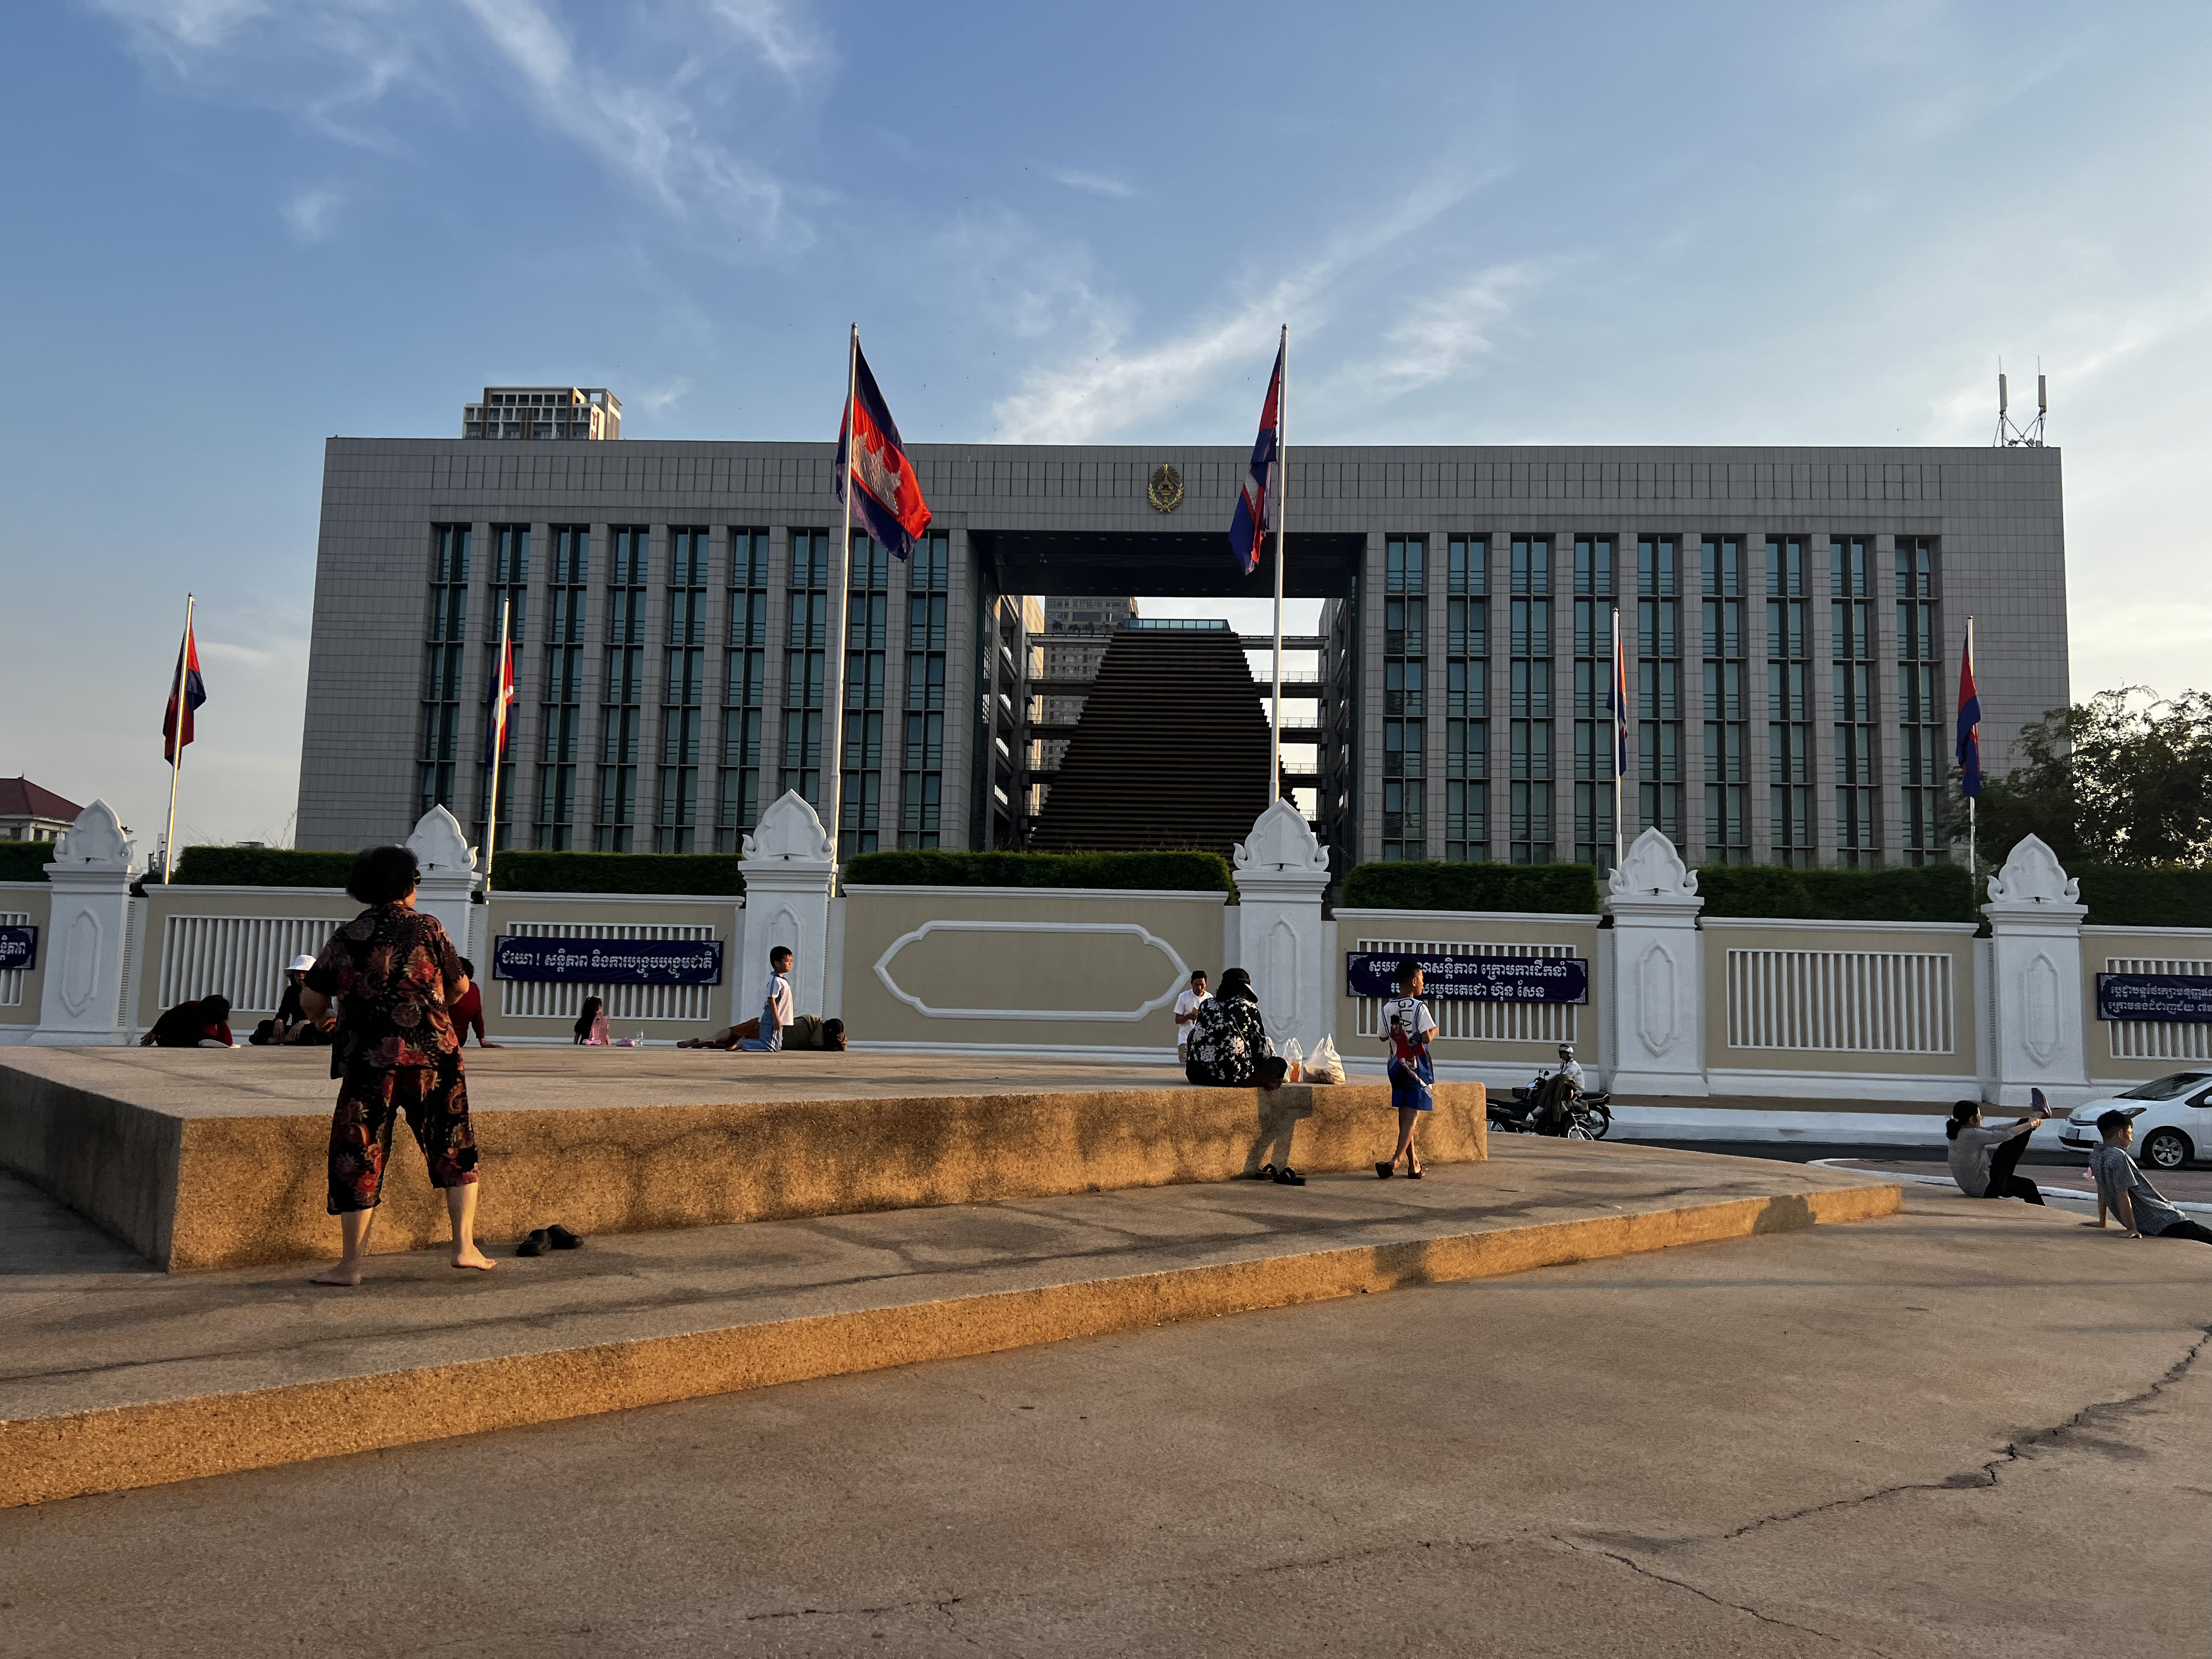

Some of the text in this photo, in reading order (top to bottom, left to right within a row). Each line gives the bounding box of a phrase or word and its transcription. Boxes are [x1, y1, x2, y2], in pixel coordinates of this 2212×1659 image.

[545, 948, 588, 972] សន្តិភាព
[591, 949, 712, 978] និងការបង្រួបបង្រួមជាតិ
[1481, 959, 1567, 980] ក្រោមការដឹកនាំ
[1490, 982, 1514, 1001] ហ៊ុន
[1517, 979, 1545, 998] សែន
